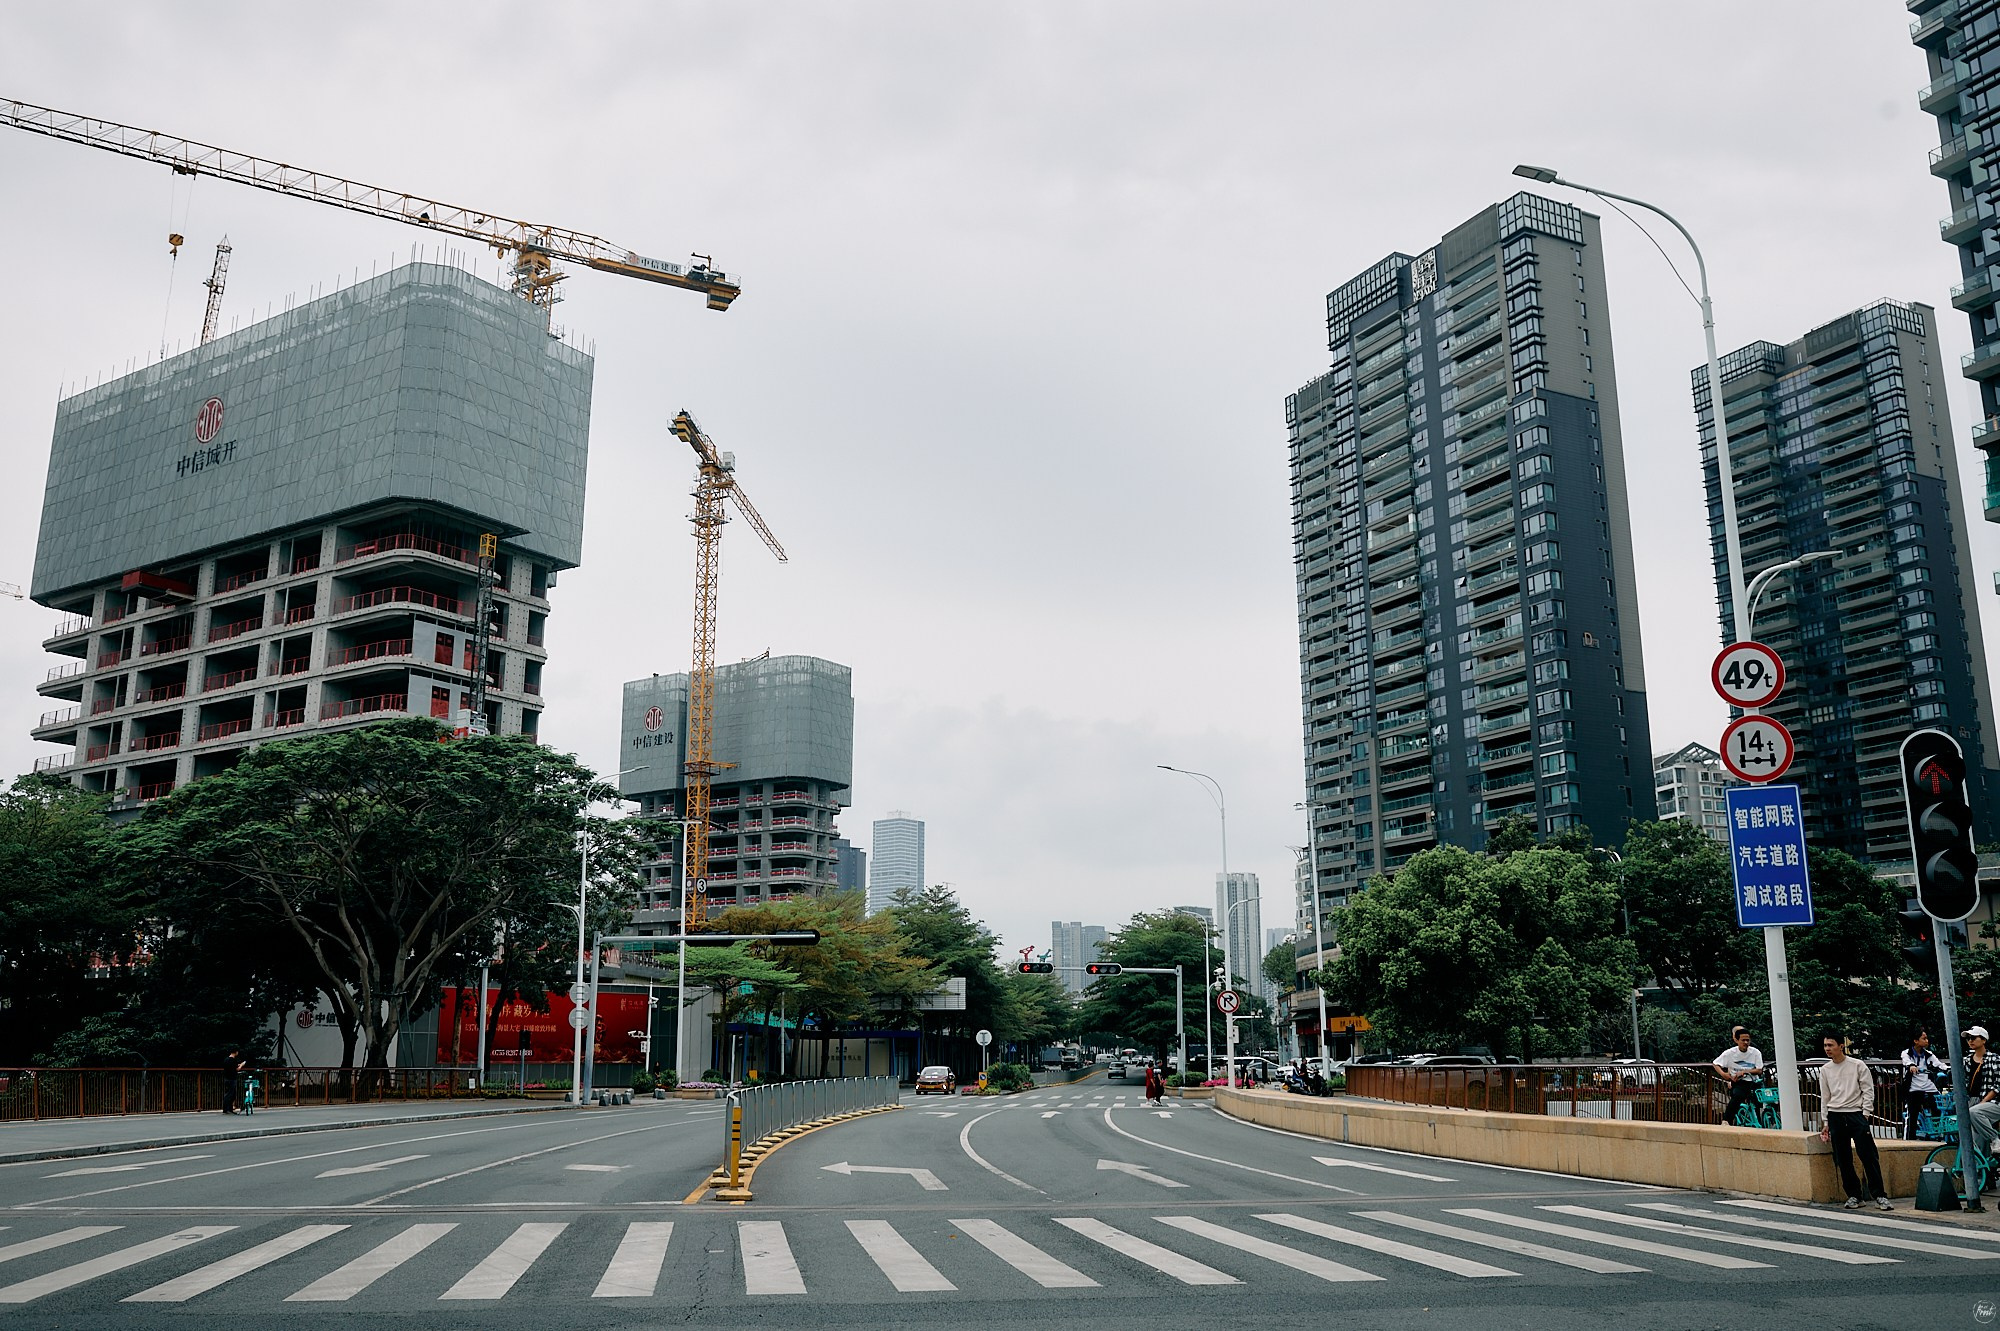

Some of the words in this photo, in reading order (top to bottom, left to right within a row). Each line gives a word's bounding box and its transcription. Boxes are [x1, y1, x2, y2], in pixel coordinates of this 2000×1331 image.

[641, 258, 679, 274] 中信建设
[176, 439, 237, 478] 中信城开
[1722, 659, 1773, 690] 49t
[633, 731, 674, 749] 中信建设
[1736, 730, 1774, 752] 14t
[1734, 804, 1796, 829] 智能网联
[1739, 843, 1800, 867] 汽车道路
[1743, 883, 1805, 907] 测试路段
